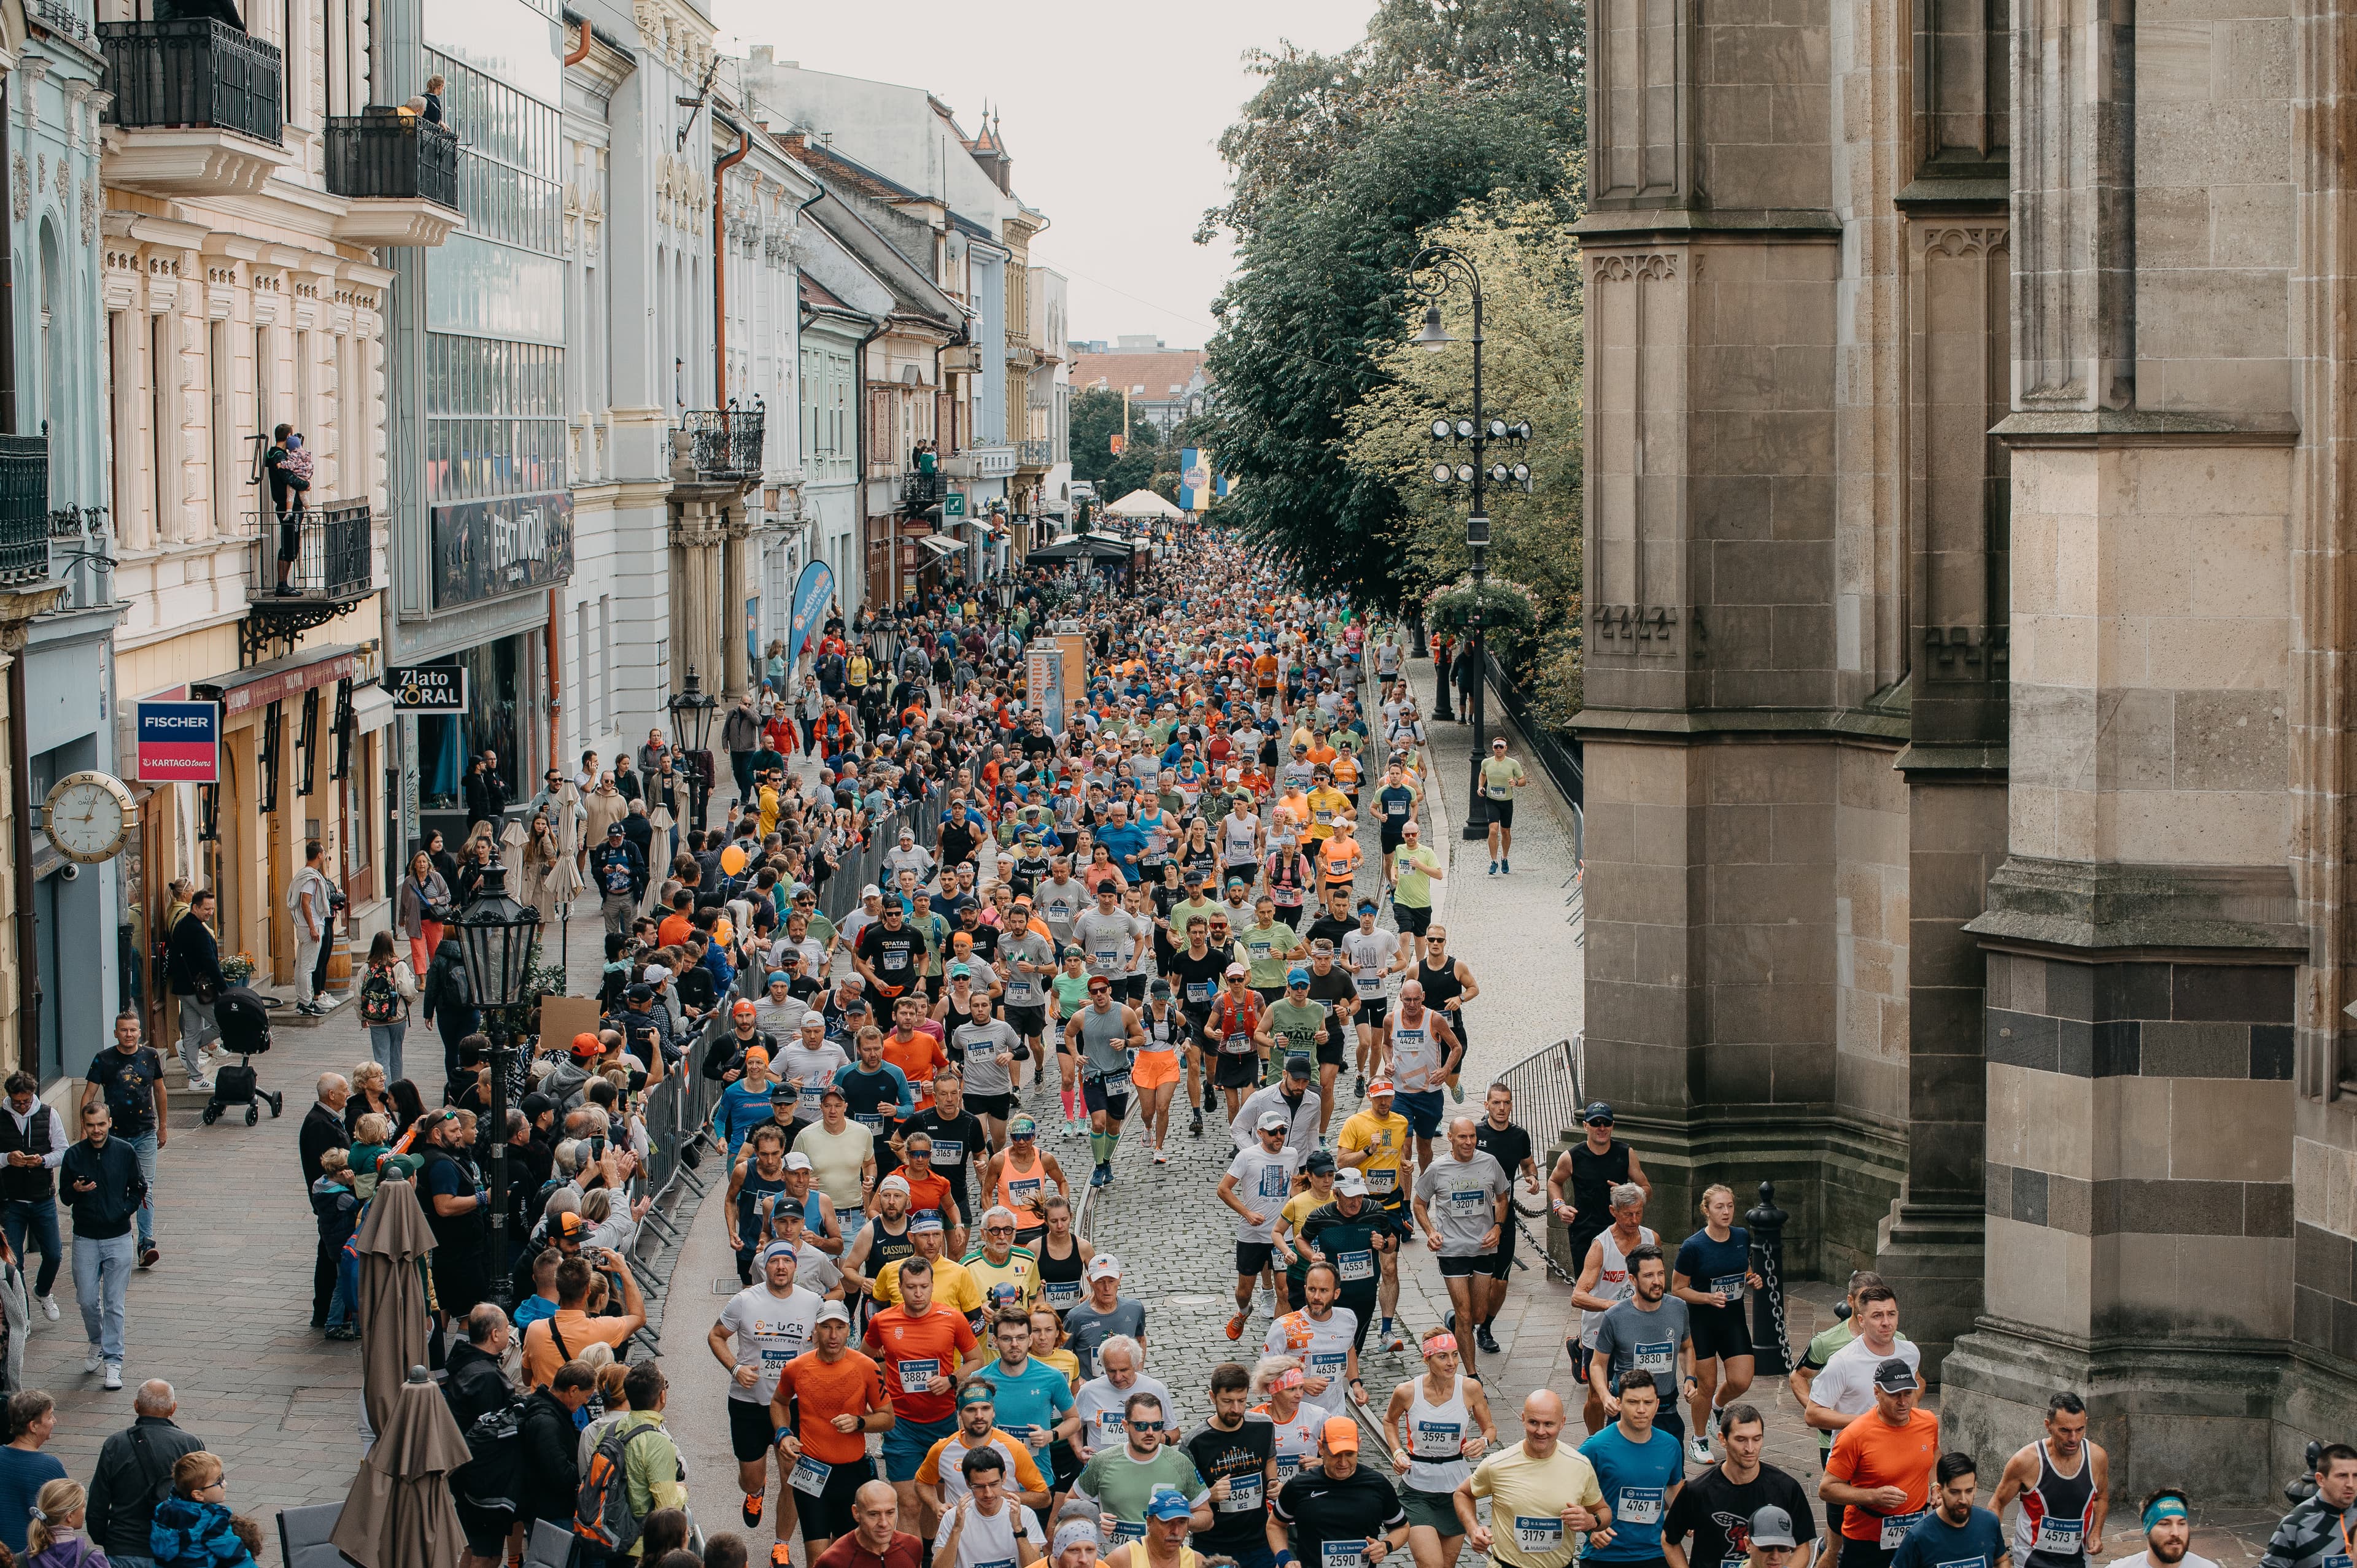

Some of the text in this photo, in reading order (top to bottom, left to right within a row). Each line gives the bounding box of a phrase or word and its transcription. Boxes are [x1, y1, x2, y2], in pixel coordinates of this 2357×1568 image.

[517, 504, 546, 563] MODA
[400, 670, 448, 686] Zlato
[1046, 657, 1056, 690] IGOR
[145, 717, 208, 727] FISCHER
[1015, 1189, 1031, 1197] 1567
[1456, 1200, 1474, 1208] 3207
[883, 1245, 914, 1256] CASSOVIA
[1344, 1262, 1364, 1272] 4553
[1716, 1283, 1735, 1293] 4330
[1050, 1292, 1070, 1301] 3440
[1639, 1354, 1661, 1364] 3830
[765, 1360, 786, 1369] 2843
[1316, 1364, 1336, 1375] 4635
[904, 1372, 927, 1382] 3882
[1109, 1424, 1127, 1434] 476
[1422, 1432, 1446, 1442] 3595
[794, 1466, 813, 1481] 3700
[1277, 1466, 1293, 1477] 209
[1627, 1500, 1650, 1512] 4767
[1522, 1529, 1546, 1541] 3179
[2045, 1531, 2070, 1543] 4573
[1329, 1555, 1355, 1567] 2590
